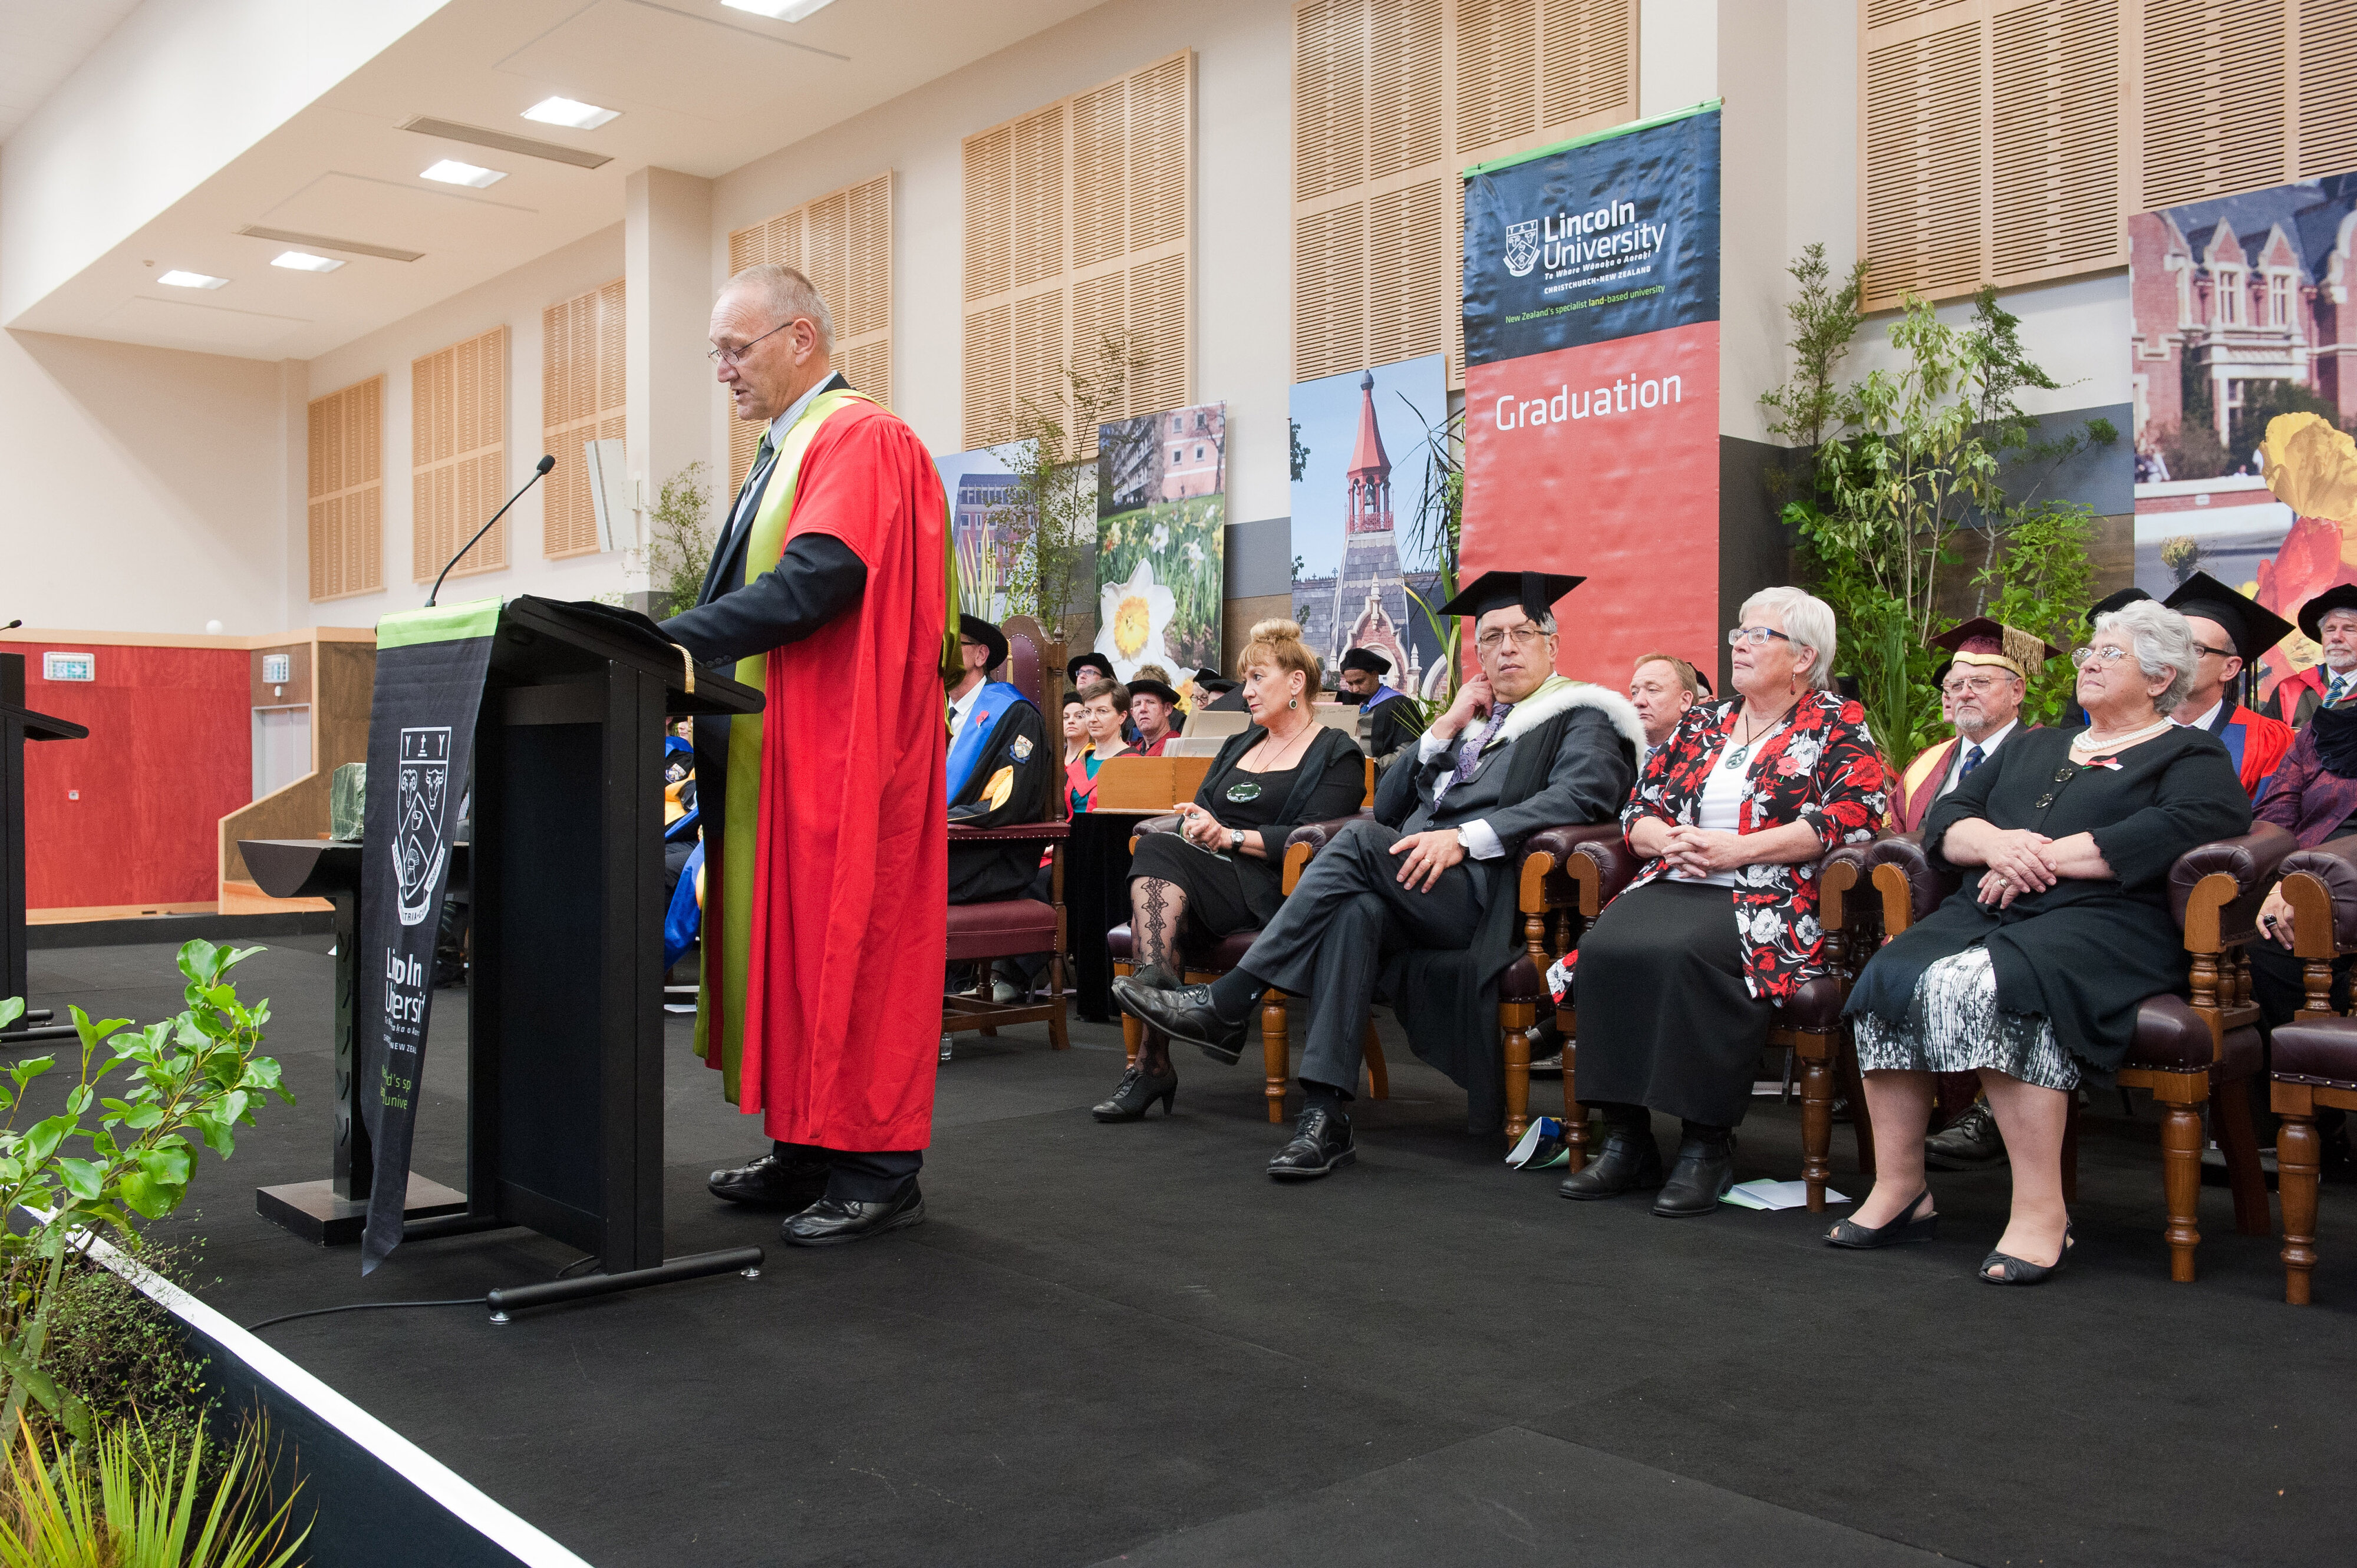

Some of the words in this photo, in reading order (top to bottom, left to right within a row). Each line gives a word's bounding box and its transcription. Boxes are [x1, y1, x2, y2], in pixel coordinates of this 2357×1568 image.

[1544, 200, 1635, 243] Lincoln
[1544, 223, 1667, 270] University
[1556, 266, 1580, 278] Whare
[1618, 265, 1651, 279] ZEALAND
[1505, 315, 1521, 323] New
[1522, 308, 1554, 321] Zealand's
[1555, 301, 1588, 315] specialist
[1588, 290, 1629, 307] land-based
[1630, 285, 1666, 299] university
[1496, 373, 1681, 431] Graduation
